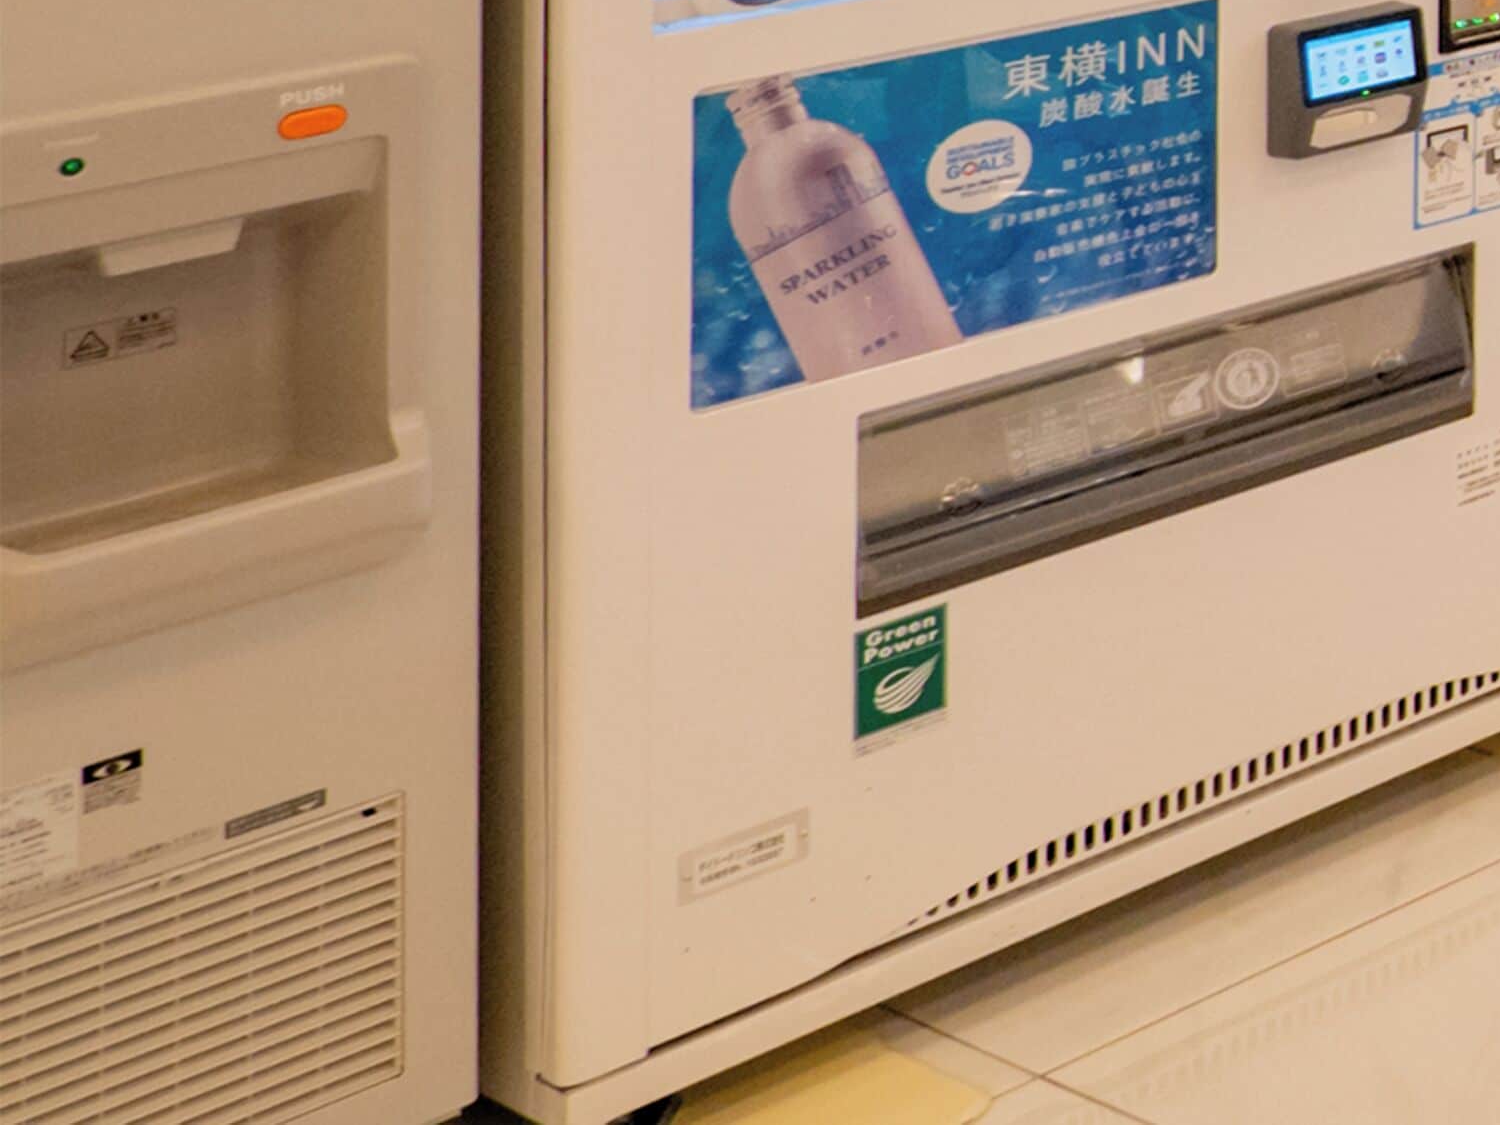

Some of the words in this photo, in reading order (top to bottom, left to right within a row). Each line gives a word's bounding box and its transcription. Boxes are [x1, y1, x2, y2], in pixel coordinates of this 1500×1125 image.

[1002, 24, 1207, 102] 東横INN
[279, 82, 345, 108] PUSH
[1038, 70, 1202, 129] 炭酸水誕生
[946, 152, 1015, 180] GOALS
[779, 222, 897, 297] SPARKLING
[806, 253, 892, 307] WATER
[862, 628, 939, 665] Power
[864, 615, 937, 649] Green
